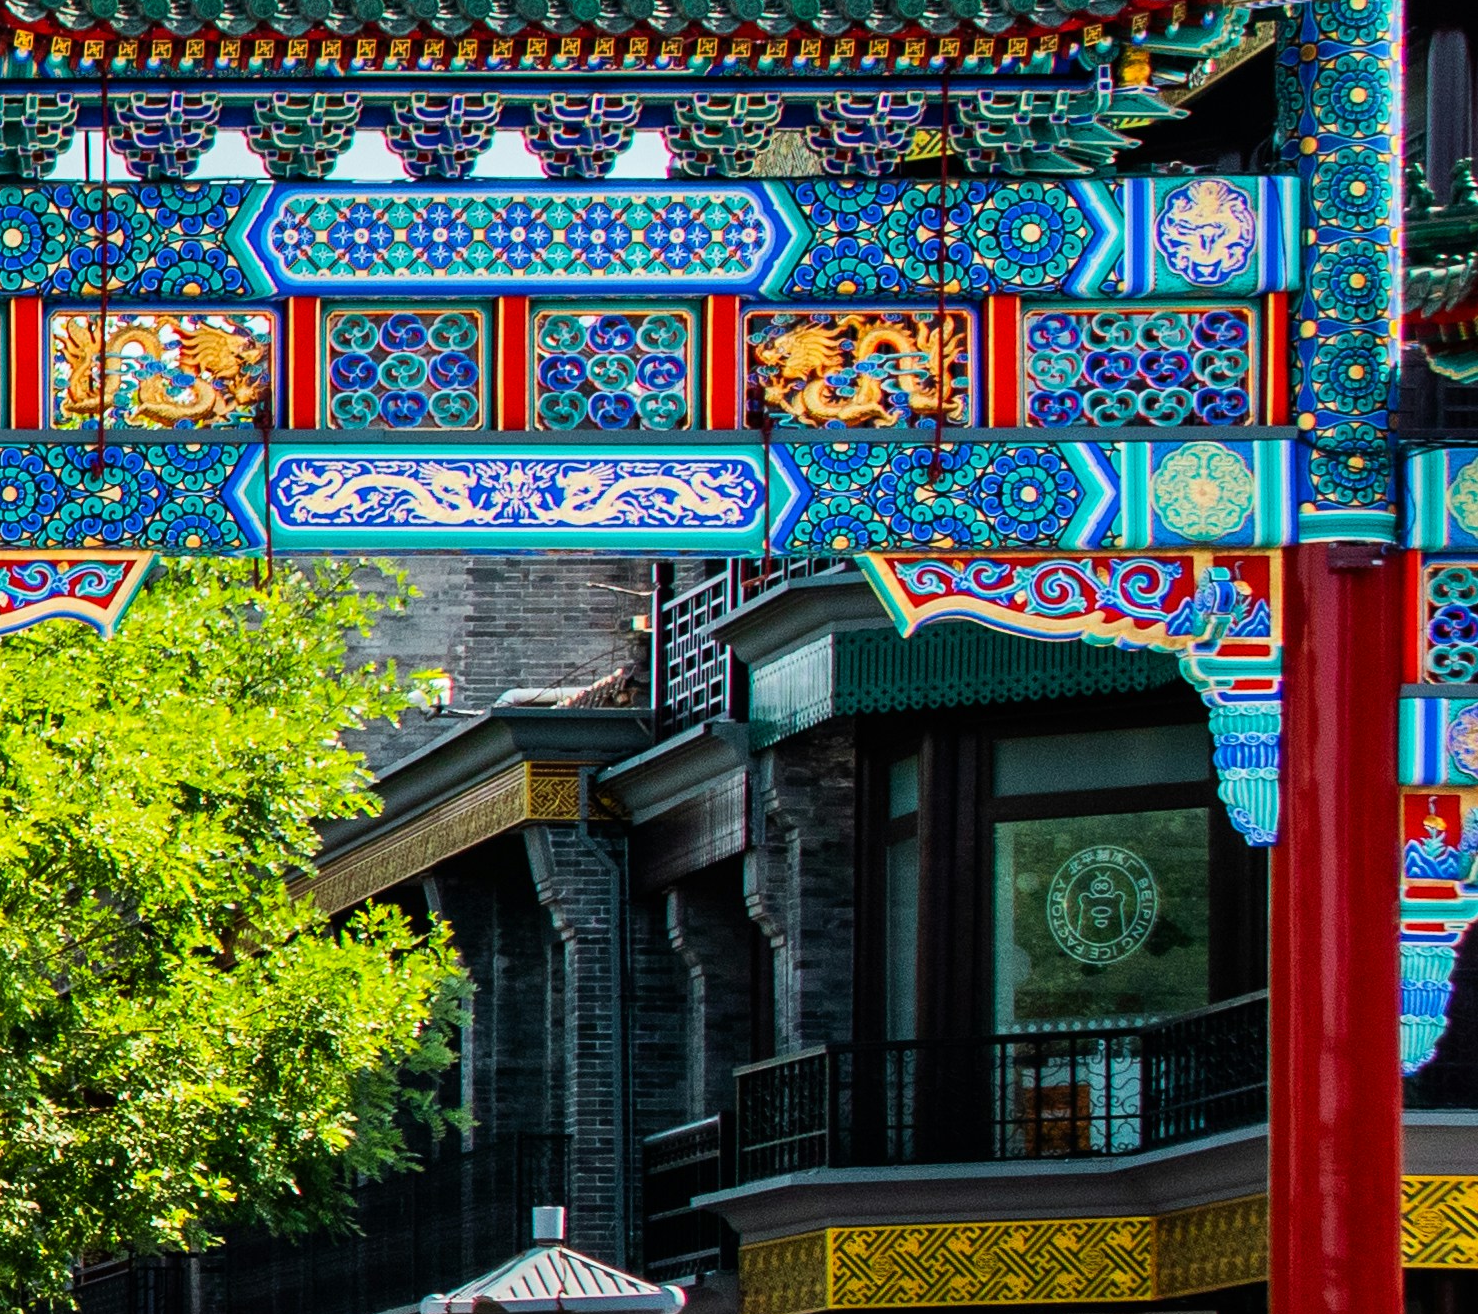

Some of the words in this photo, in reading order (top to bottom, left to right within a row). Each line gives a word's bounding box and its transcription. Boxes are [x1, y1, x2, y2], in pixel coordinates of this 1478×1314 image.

[1051, 878, 1085, 955] FACTORY
[1121, 877, 1153, 950] BEIPING
[1089, 945, 1118, 959] ICE
